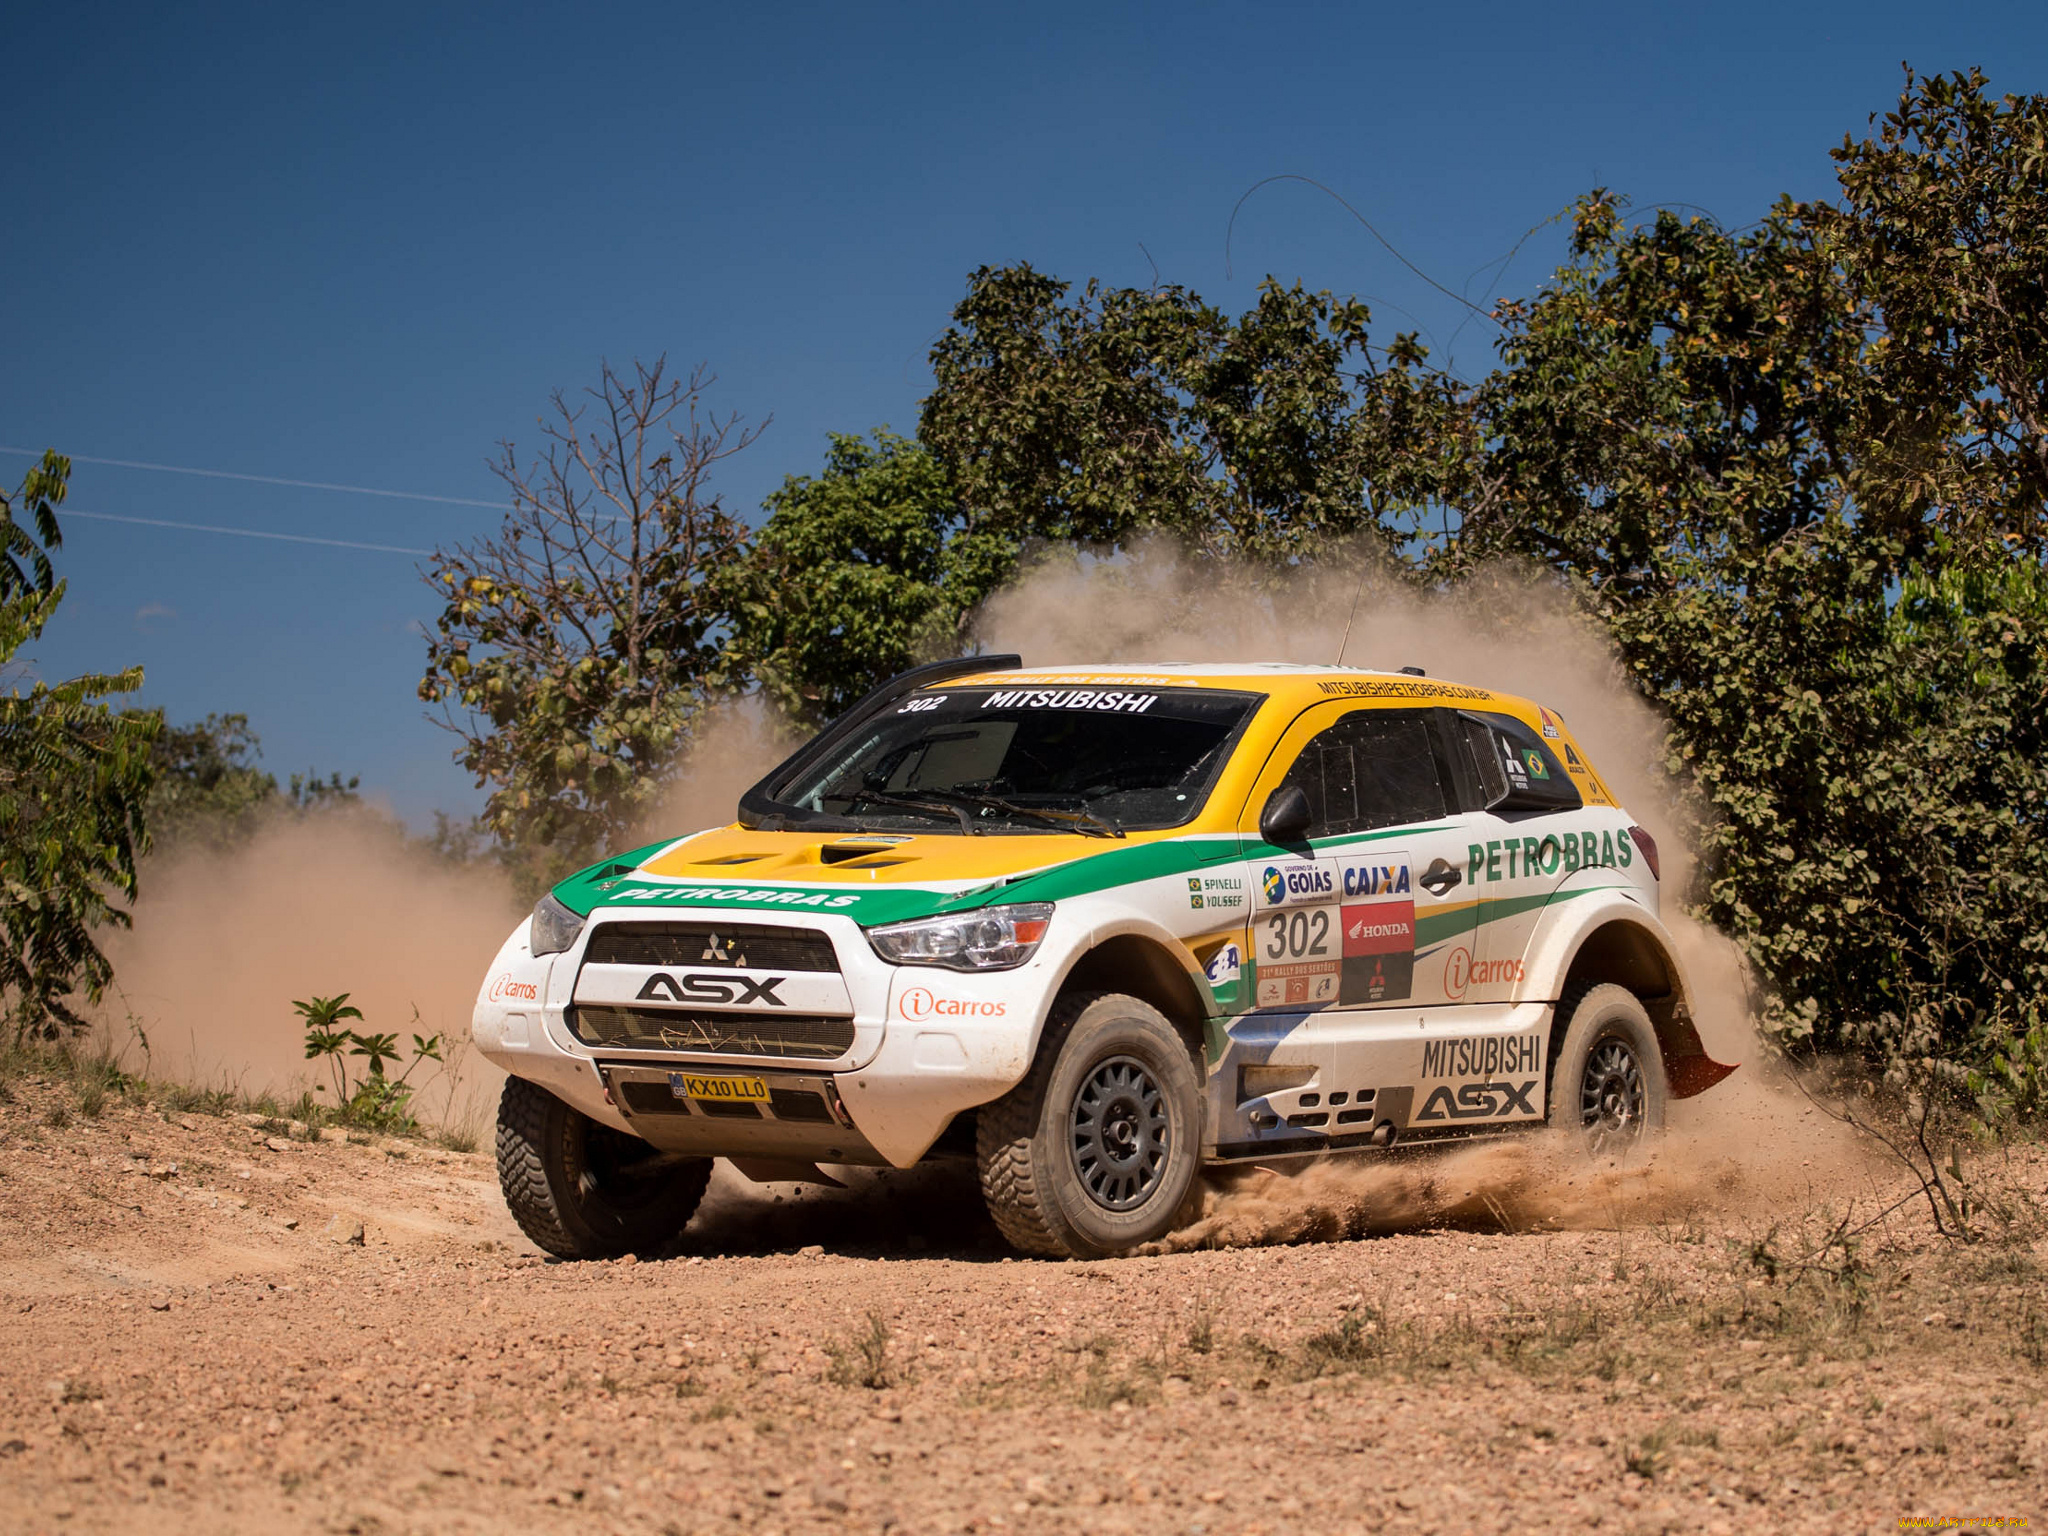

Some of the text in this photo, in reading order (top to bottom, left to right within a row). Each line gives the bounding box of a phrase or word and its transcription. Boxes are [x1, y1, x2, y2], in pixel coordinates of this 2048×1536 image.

[897, 690, 1158, 714] 302 MITSUBISHI
[1317, 682, 1495, 701] MITSUBISHIPETROBRAS.COM.BR
[1468, 829, 1632, 885] PETROBRAS
[1204, 878, 1242, 890] SPINELLI
[1287, 866, 1333, 893] GOIÁS
[1344, 865, 1410, 896] CAIXA
[608, 888, 861, 908] PETROBRAS
[1206, 895, 1243, 907] YOUSSEF
[1267, 910, 1330, 960] 302
[1362, 923, 1410, 938] HONDA
[1274, 967, 1294, 976] RALLY
[1295, 965, 1308, 974] DOS
[1308, 962, 1336, 973] SERTÕES
[635, 973, 787, 1006] ASX
[1421, 1035, 1541, 1079] MITSUBISHI
[673, 1087, 687, 1096] GB
[686, 1078, 731, 1097] KX10
[1416, 1080, 1538, 1121] ASX
